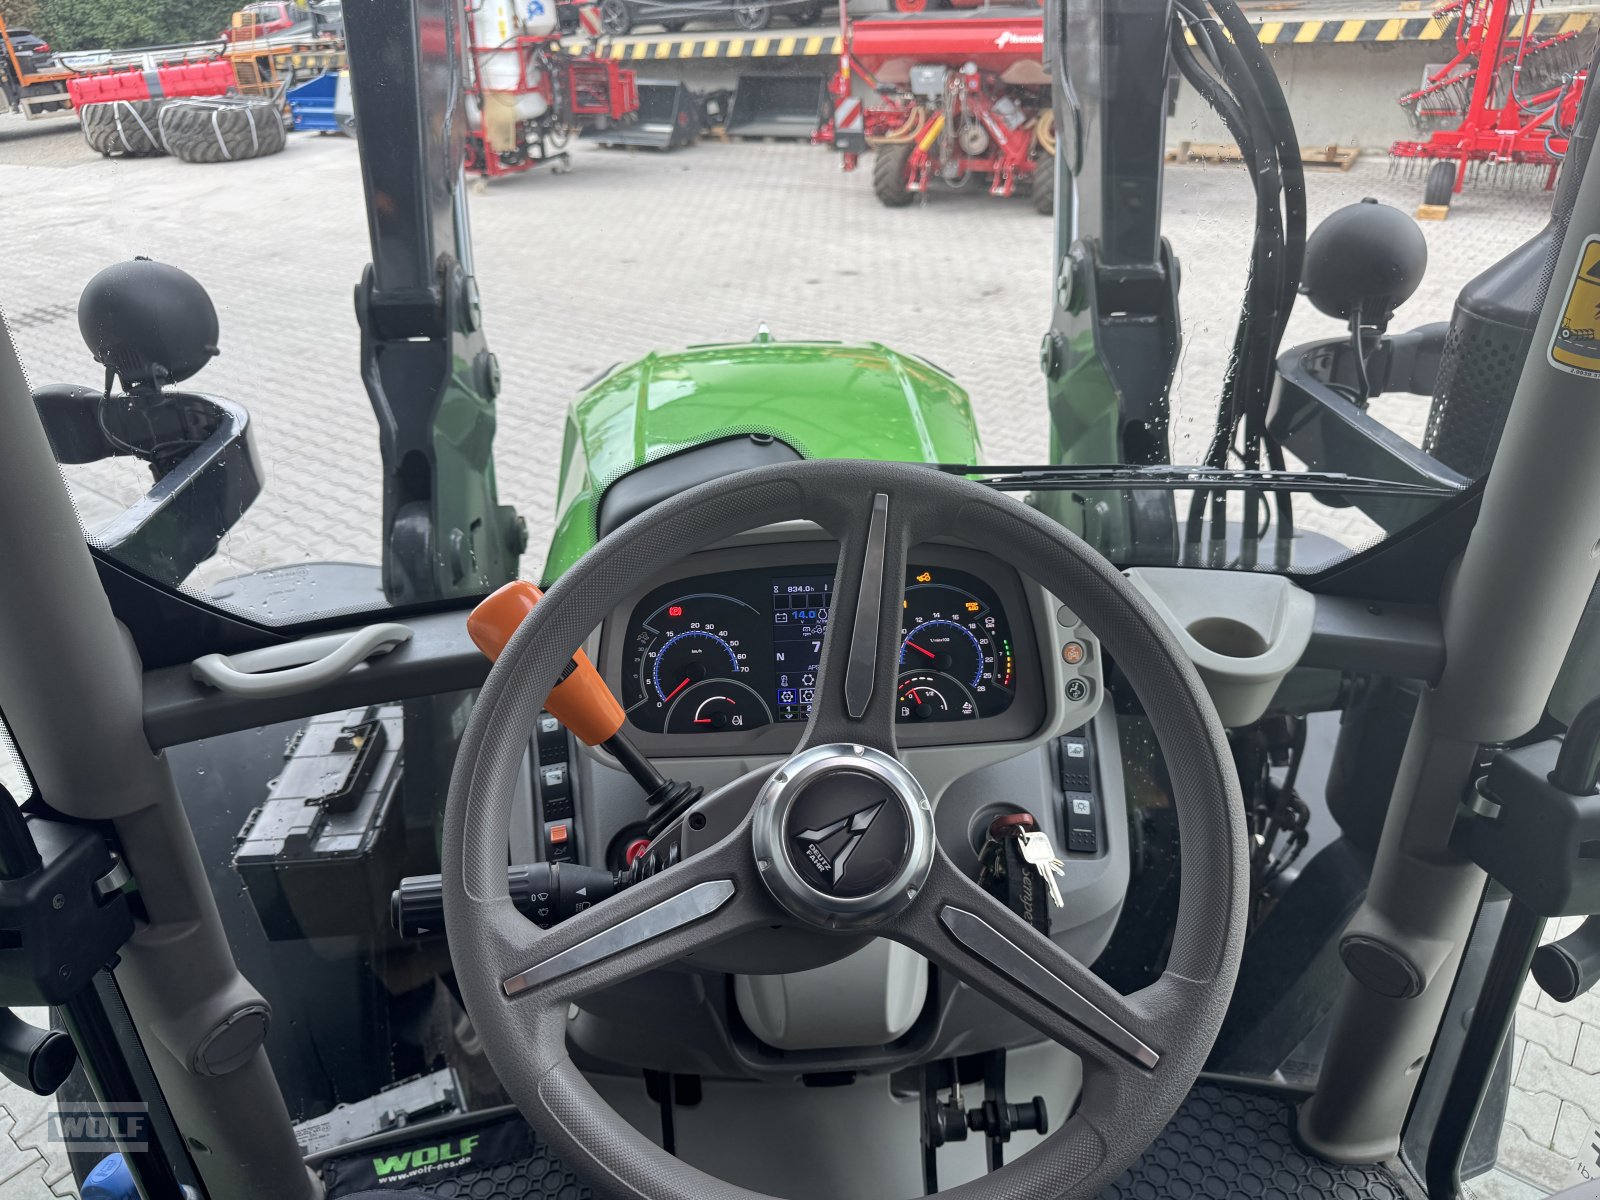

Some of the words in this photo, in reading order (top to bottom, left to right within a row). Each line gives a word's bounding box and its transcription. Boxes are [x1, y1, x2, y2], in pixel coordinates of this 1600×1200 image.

[792, 610, 816, 620] 14.0
[776, 652, 785, 661] N
[806, 704, 812, 712] 2
[805, 849, 825, 873] FAHR
[808, 843, 832, 871] DEUTZ
[372, 1135, 480, 1176] WOLF
[378, 1155, 472, 1184] www.wolf-nes.de
